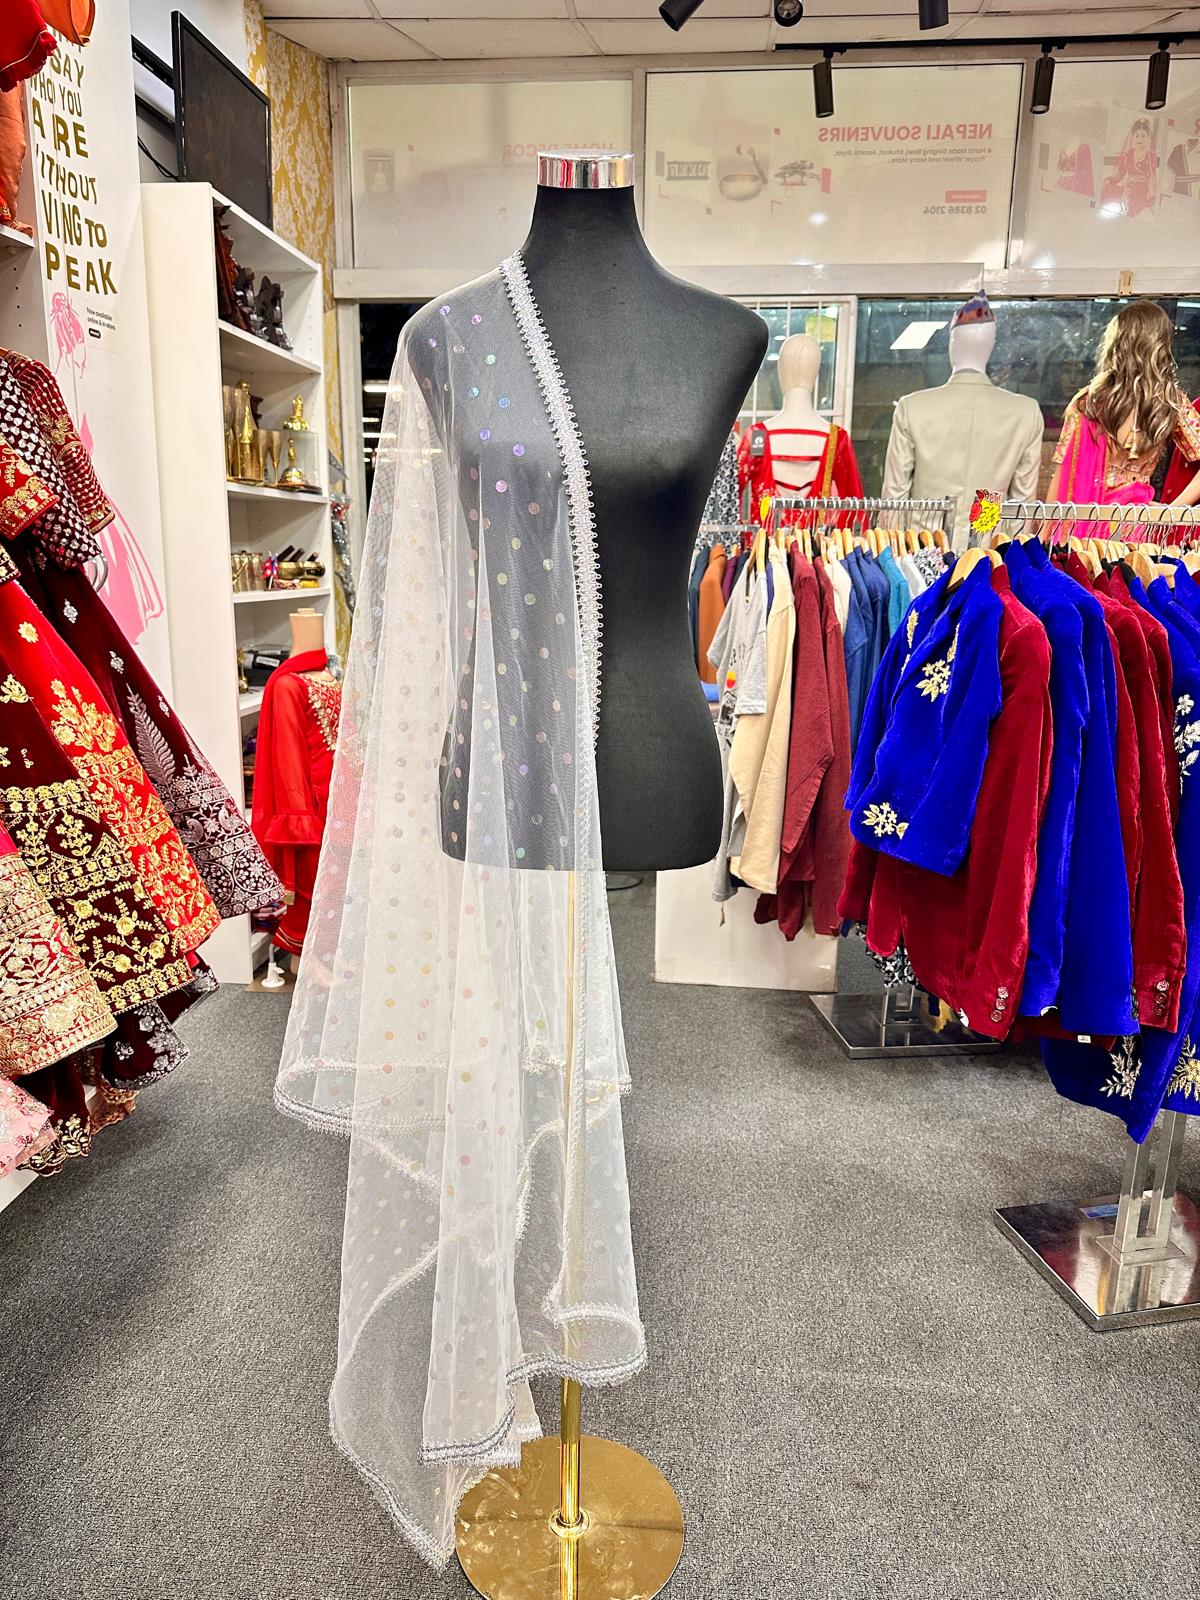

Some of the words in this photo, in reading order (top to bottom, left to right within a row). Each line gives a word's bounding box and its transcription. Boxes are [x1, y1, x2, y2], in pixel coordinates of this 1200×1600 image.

[50, 46, 84, 88] SAY
[59, 84, 82, 117] YOU
[32, 97, 89, 158] ARE
[85, 218, 107, 249] TO
